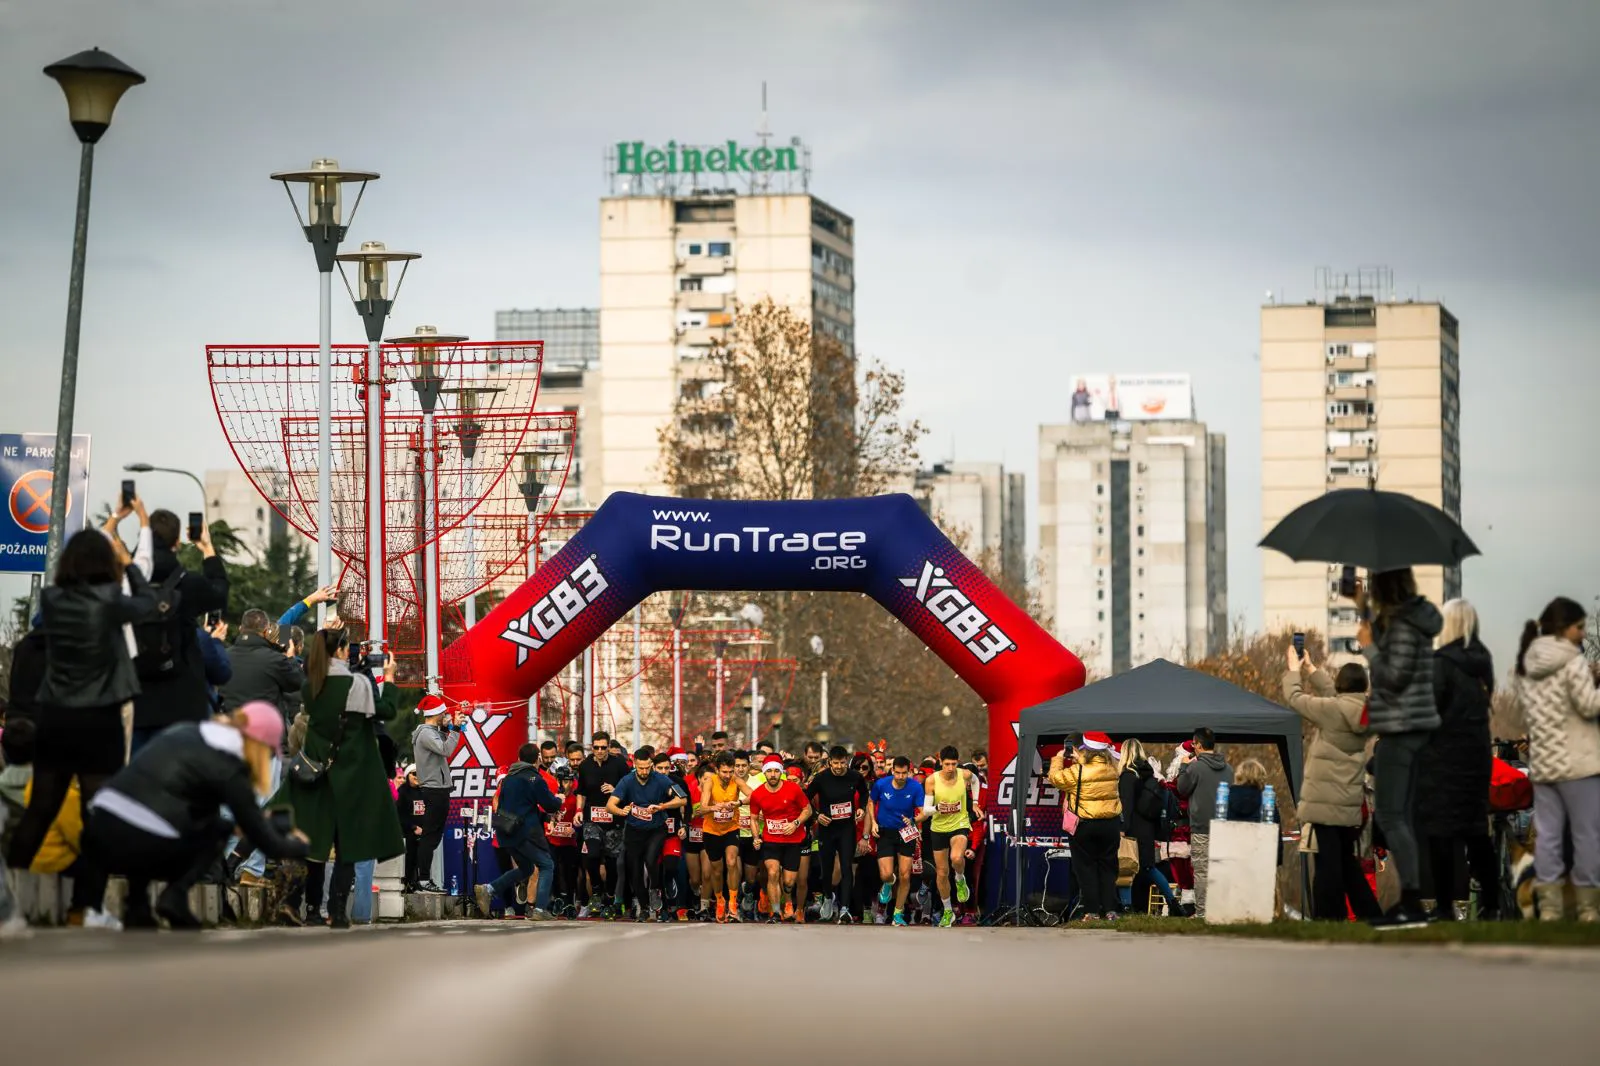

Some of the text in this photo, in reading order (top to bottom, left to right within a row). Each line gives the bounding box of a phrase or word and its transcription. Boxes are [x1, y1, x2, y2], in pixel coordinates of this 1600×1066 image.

[3, 446, 18, 457] NE
[652, 509, 711, 522] www.
[650, 524, 866, 552] RunTrace
[810, 555, 867, 570] .ORG
